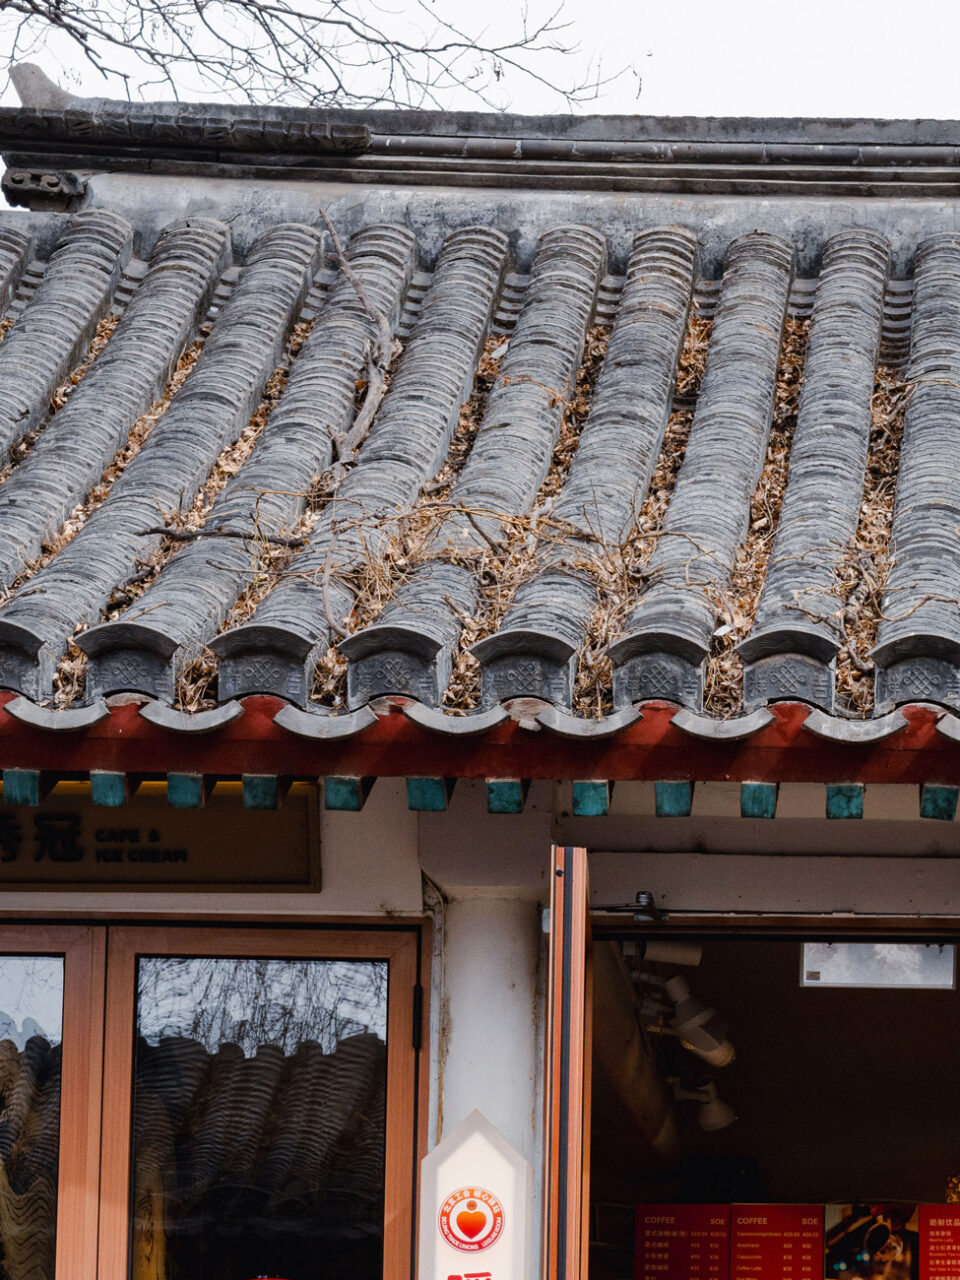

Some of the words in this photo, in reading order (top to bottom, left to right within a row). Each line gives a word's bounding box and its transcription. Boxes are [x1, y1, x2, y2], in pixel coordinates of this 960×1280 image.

[96, 829, 140, 842] CAFE
[96, 849, 122, 862] ICE
[127, 849, 188, 862] CREAM
[645, 1216, 676, 1224] COFFEE
[710, 1218, 725, 1226] SOE
[737, 1217, 768, 1225] COFFEE
[802, 1217, 819, 1225] SOE
[929, 1219, 960, 1227] 奶制饮品
